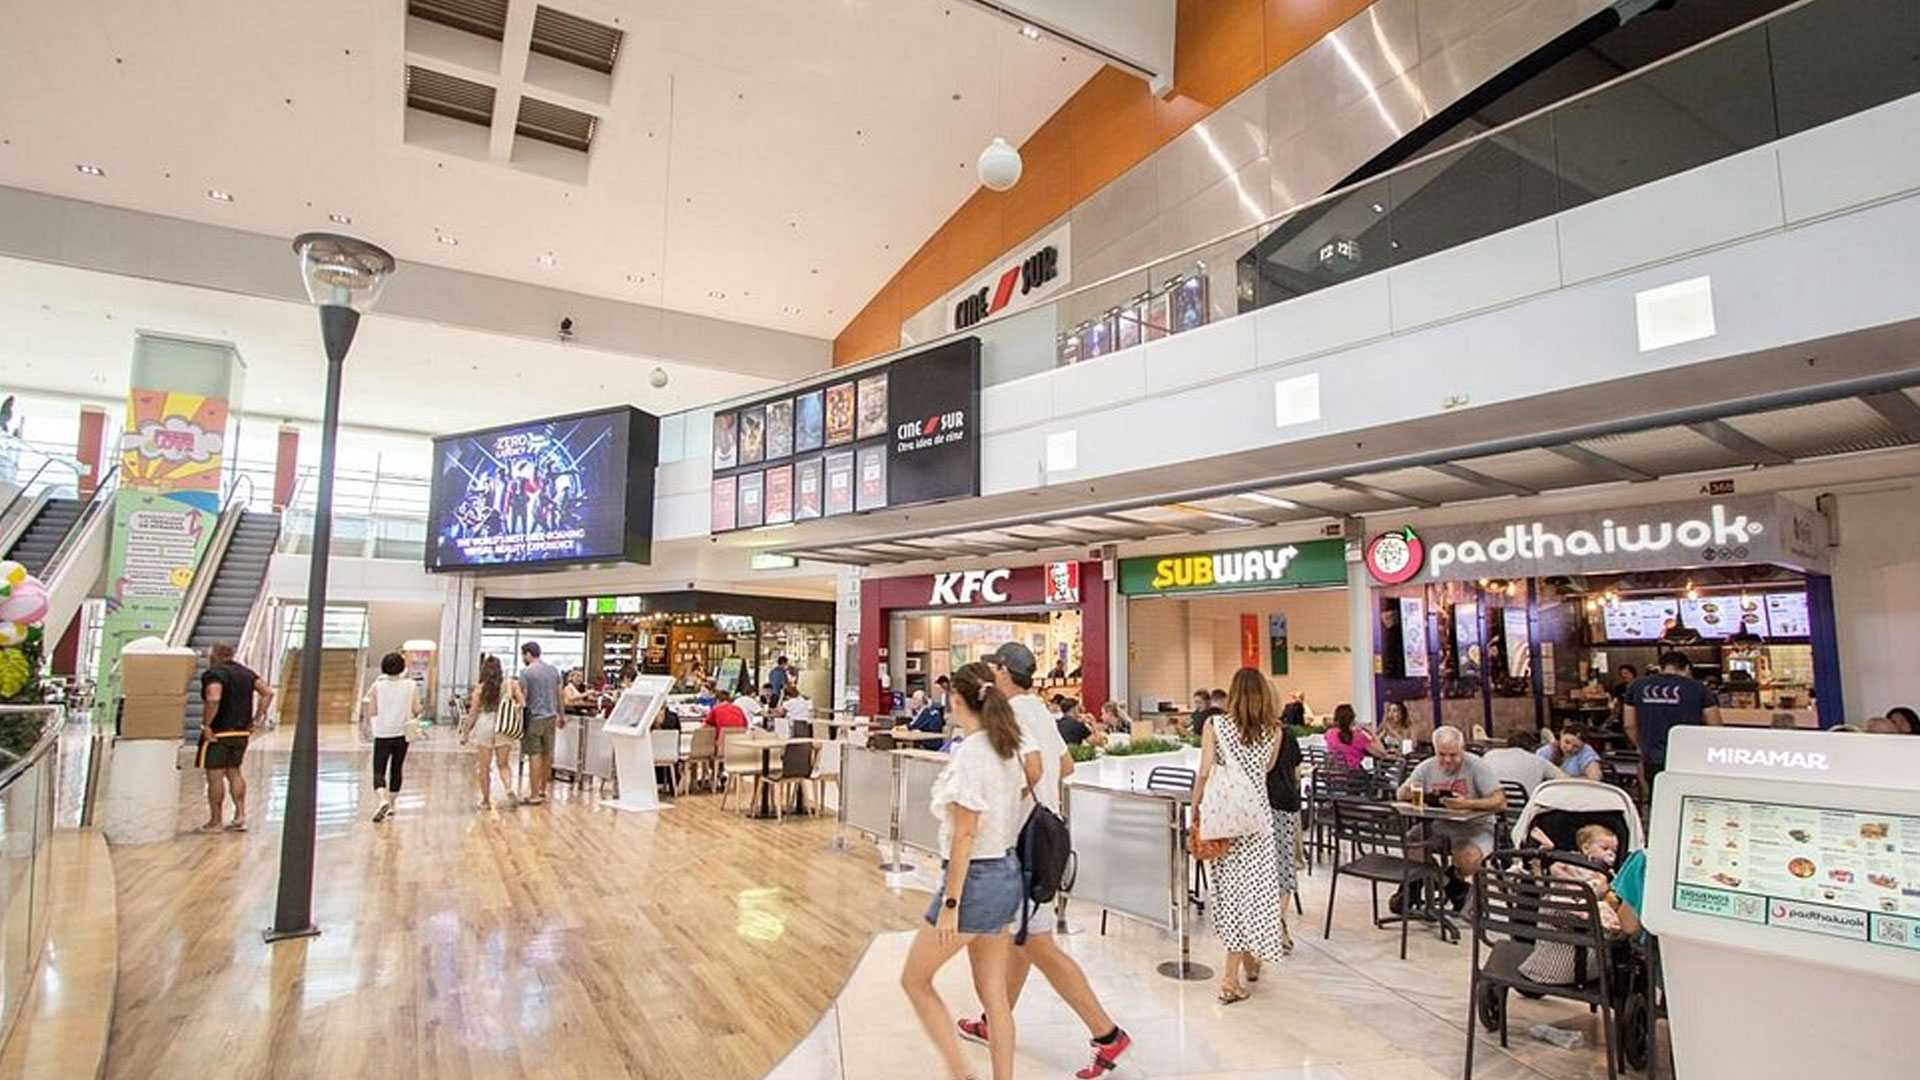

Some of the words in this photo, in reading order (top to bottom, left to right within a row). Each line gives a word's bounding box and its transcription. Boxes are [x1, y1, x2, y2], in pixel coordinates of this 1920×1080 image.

[955, 286, 989, 330] CINE
[1021, 246, 1058, 295] SUR
[897, 420, 923, 440] CINE
[941, 411, 964, 431] SUR
[916, 437, 933, 449] idea
[934, 434, 945, 446] de
[946, 431, 964, 442] cine
[1430, 504, 1749, 577] padthaiwok
[1152, 545, 1299, 589] SUBWAY
[929, 569, 1011, 606] KFC
[1707, 746, 1829, 770] MIRAMAR
